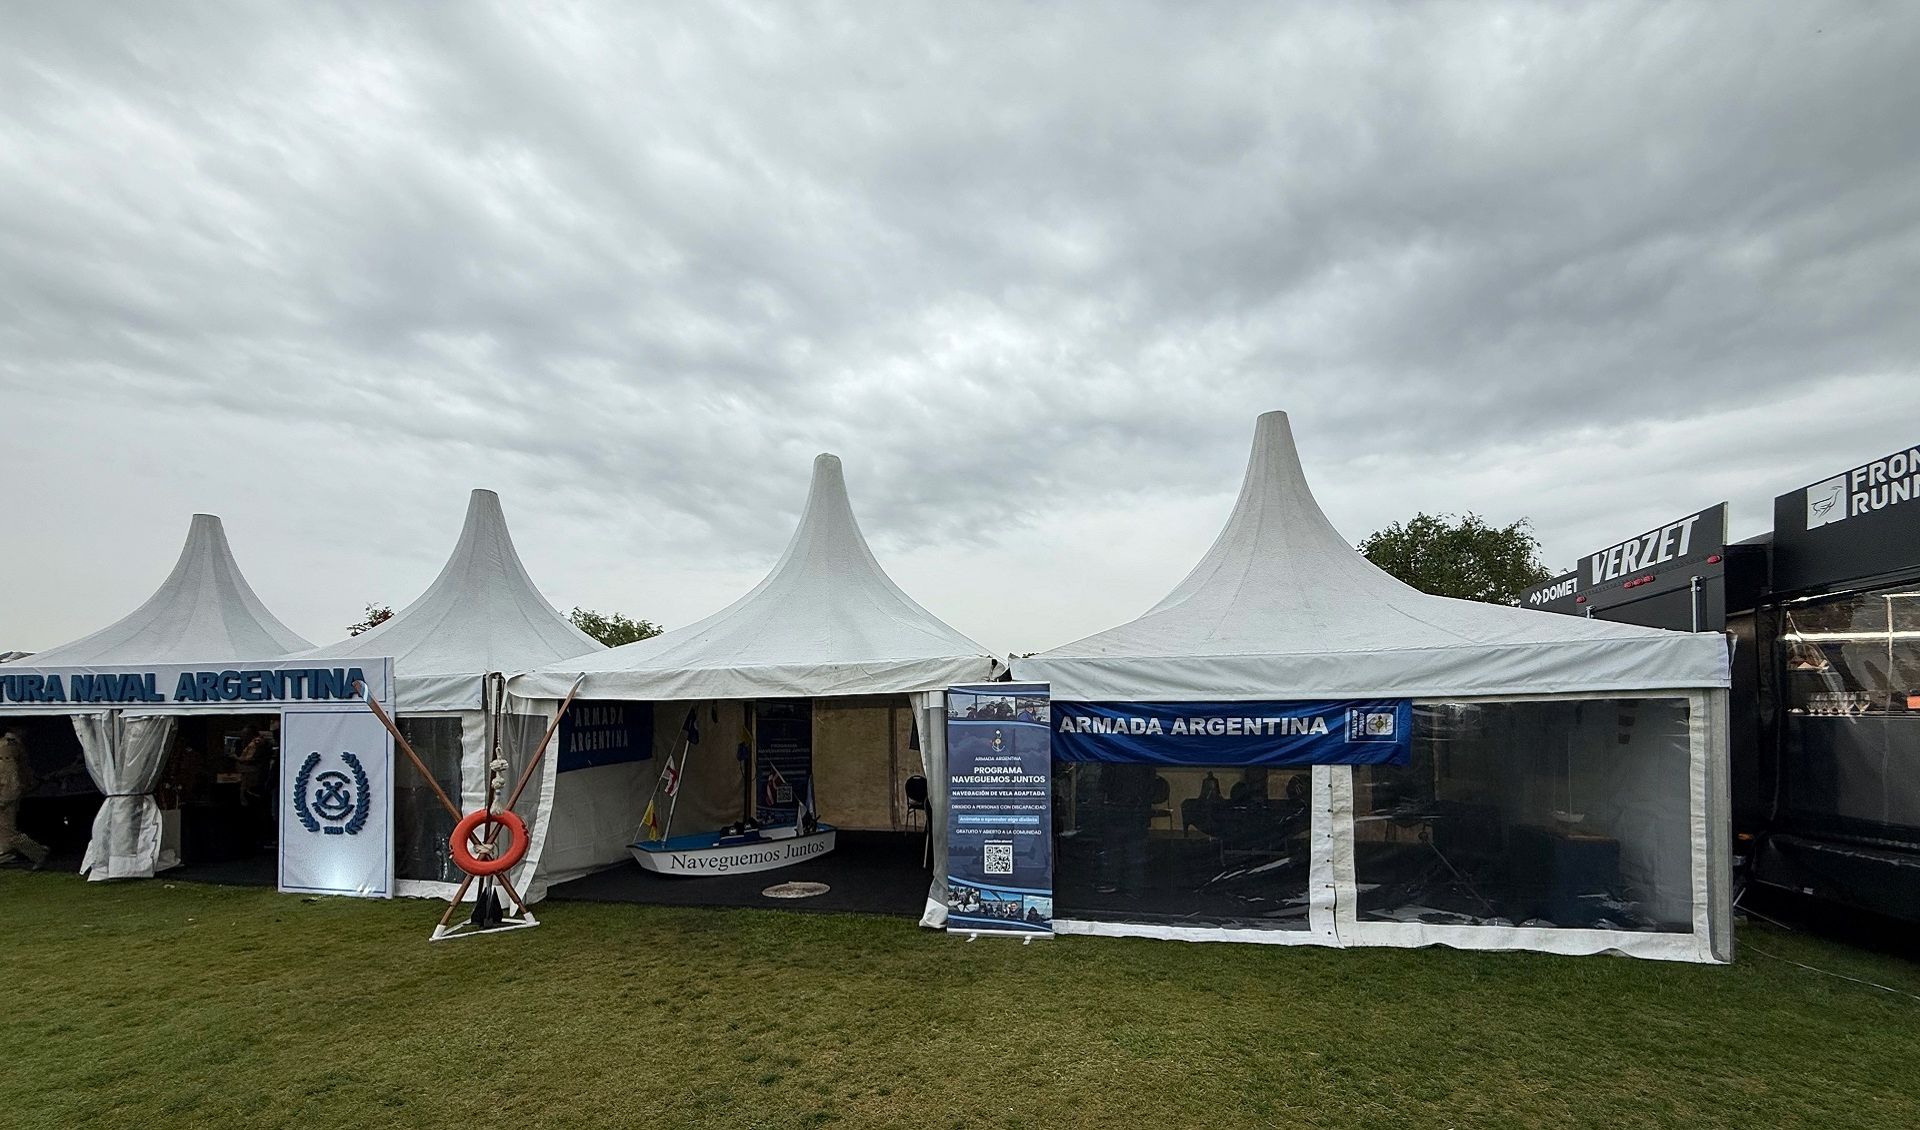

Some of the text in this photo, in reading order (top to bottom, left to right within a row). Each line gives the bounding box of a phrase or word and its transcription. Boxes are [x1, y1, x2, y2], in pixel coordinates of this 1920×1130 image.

[1591, 514, 1700, 586] VERZET
[70, 672, 165, 703] NAVAL
[173, 667, 367, 702] ARGENTINA
[574, 706, 624, 727] ARMADA
[1058, 716, 1329, 736] ARMADA ARGENTINA
[570, 729, 629, 753] ARGENTINA
[952, 775, 1046, 783] NAVEGUEMOS JUNTOS
[974, 766, 1023, 774] PROGRAMA
[670, 840, 825, 871] Naveguemos Juntos
